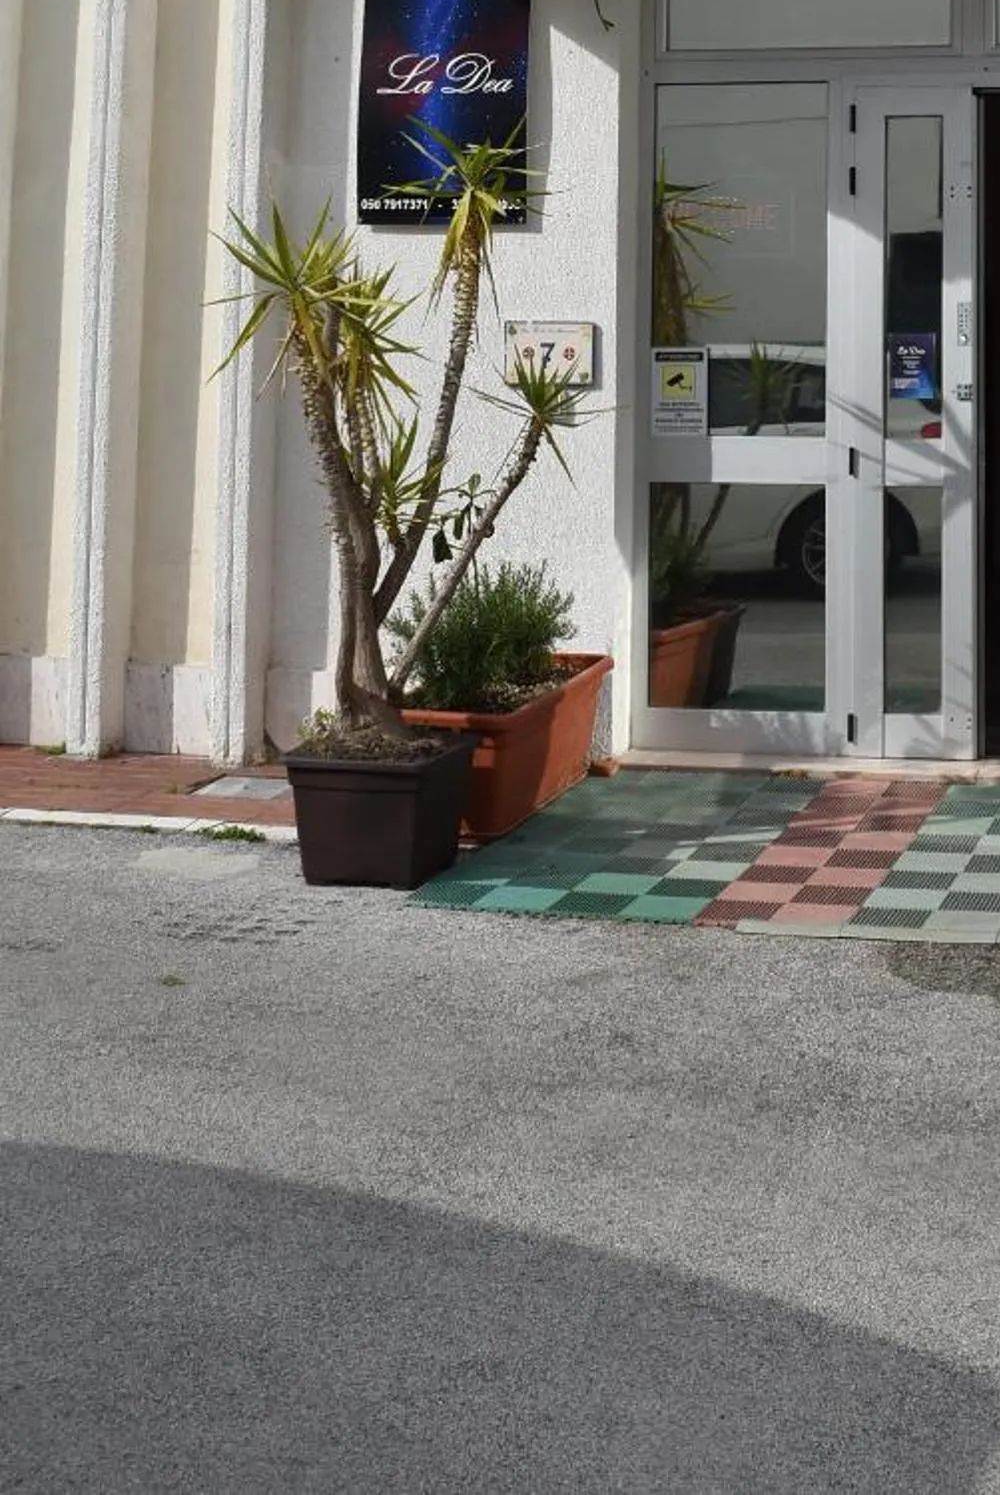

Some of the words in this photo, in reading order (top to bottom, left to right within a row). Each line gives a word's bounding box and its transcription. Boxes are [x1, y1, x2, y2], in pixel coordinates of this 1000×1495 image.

[376, 53, 439, 94] La
[441, 53, 514, 94] Dea
[539, 342, 556, 368] 7
